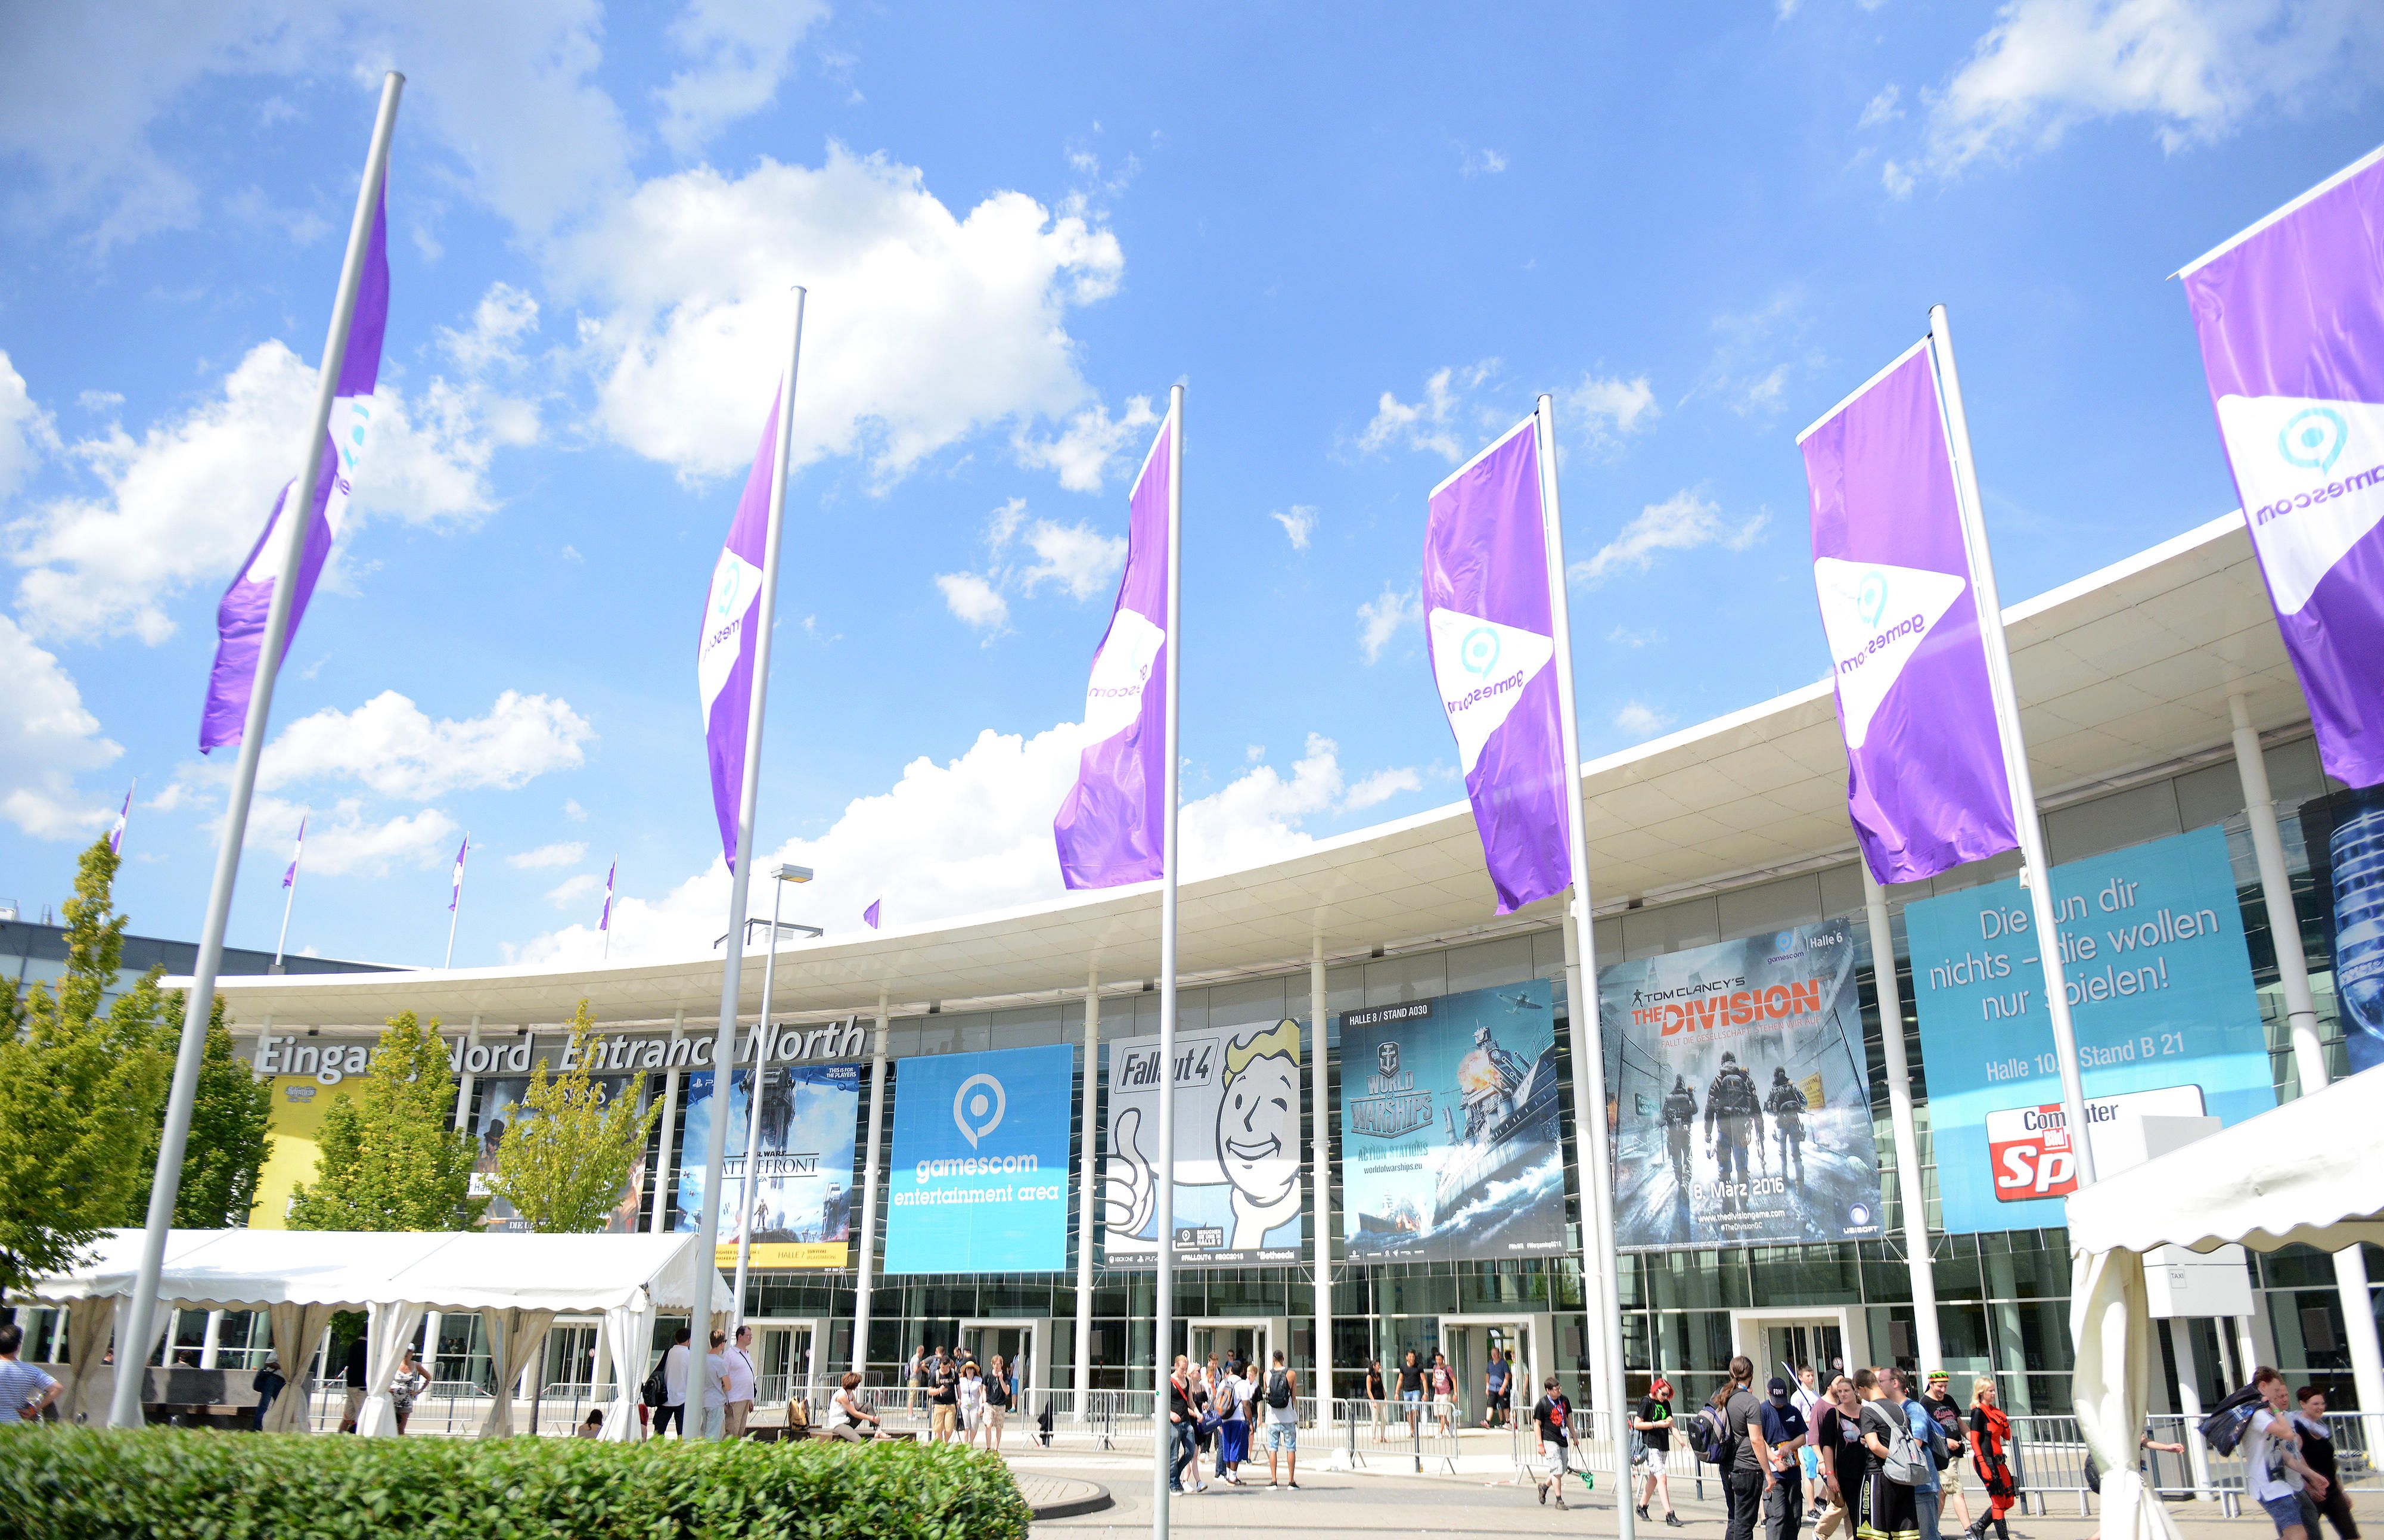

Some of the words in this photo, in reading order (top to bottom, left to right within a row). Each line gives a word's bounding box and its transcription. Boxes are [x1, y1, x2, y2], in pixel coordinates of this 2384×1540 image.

[1980, 905, 2028, 940] Die
[2053, 896, 2088, 924] un
[2099, 877, 2139, 912] dir
[1810, 935, 1834, 949] Halle
[1836, 932, 1843, 943] 6
[1930, 952, 2011, 992] nichts
[2107, 908, 2220, 954] wollen
[1767, 952, 1805, 965] gamescom
[1644, 991, 1674, 1002] TOM
[1677, 976, 1745, 997] CLANCY'S
[1982, 990, 2030, 1021] nur
[2044, 956, 2169, 1008] pielen!
[1349, 1014, 1371, 1026] HALLE
[1372, 1013, 1377, 1022] 8
[1383, 1008, 1407, 1020] STAND
[1408, 1005, 1427, 1017] A030
[1631, 1005, 1663, 1026] THE
[1660, 979, 1821, 1036] DIVISION
[1683, 1036, 1695, 1044] DIE
[1696, 1027, 1751, 1042] GESELLSCHAFT
[1754, 1022, 1784, 1033] STEHEN
[259, 1036, 420, 1085] Einga
[559, 1033, 736, 1070] Entranc
[741, 1016, 867, 1063] North
[1986, 1057, 2029, 1082] Halle
[2079, 1039, 2135, 1067] Stand
[2141, 1037, 2155, 1058] B
[2160, 1031, 2184, 1055] 21
[1122, 1048, 1194, 1086] Fallut
[1195, 1045, 1212, 1079] 4
[1367, 1070, 1414, 1095] WORLD
[1351, 1095, 1433, 1134] WARSHIPS
[1358, 1145, 1387, 1162] ACTION
[1389, 1141, 1429, 1157] STATIONS
[723, 1157, 819, 1175] ATTEFRONT
[915, 1154, 1038, 1184] gamescom
[1364, 1163, 1423, 1174] worldofwarships.eu
[894, 1184, 1012, 1206] entertainment
[1017, 1185, 1059, 1201] area
[1694, 1184, 1706, 1200] 8.
[1710, 1181, 1747, 1199] März
[1752, 1176, 1785, 1195] 2016
[1698, 1209, 1785, 1223] www.thedivisiongame.com
[1721, 1222, 1763, 1231] #TheDivisionGC
[1843, 1225, 1879, 1234] UBISOFT
